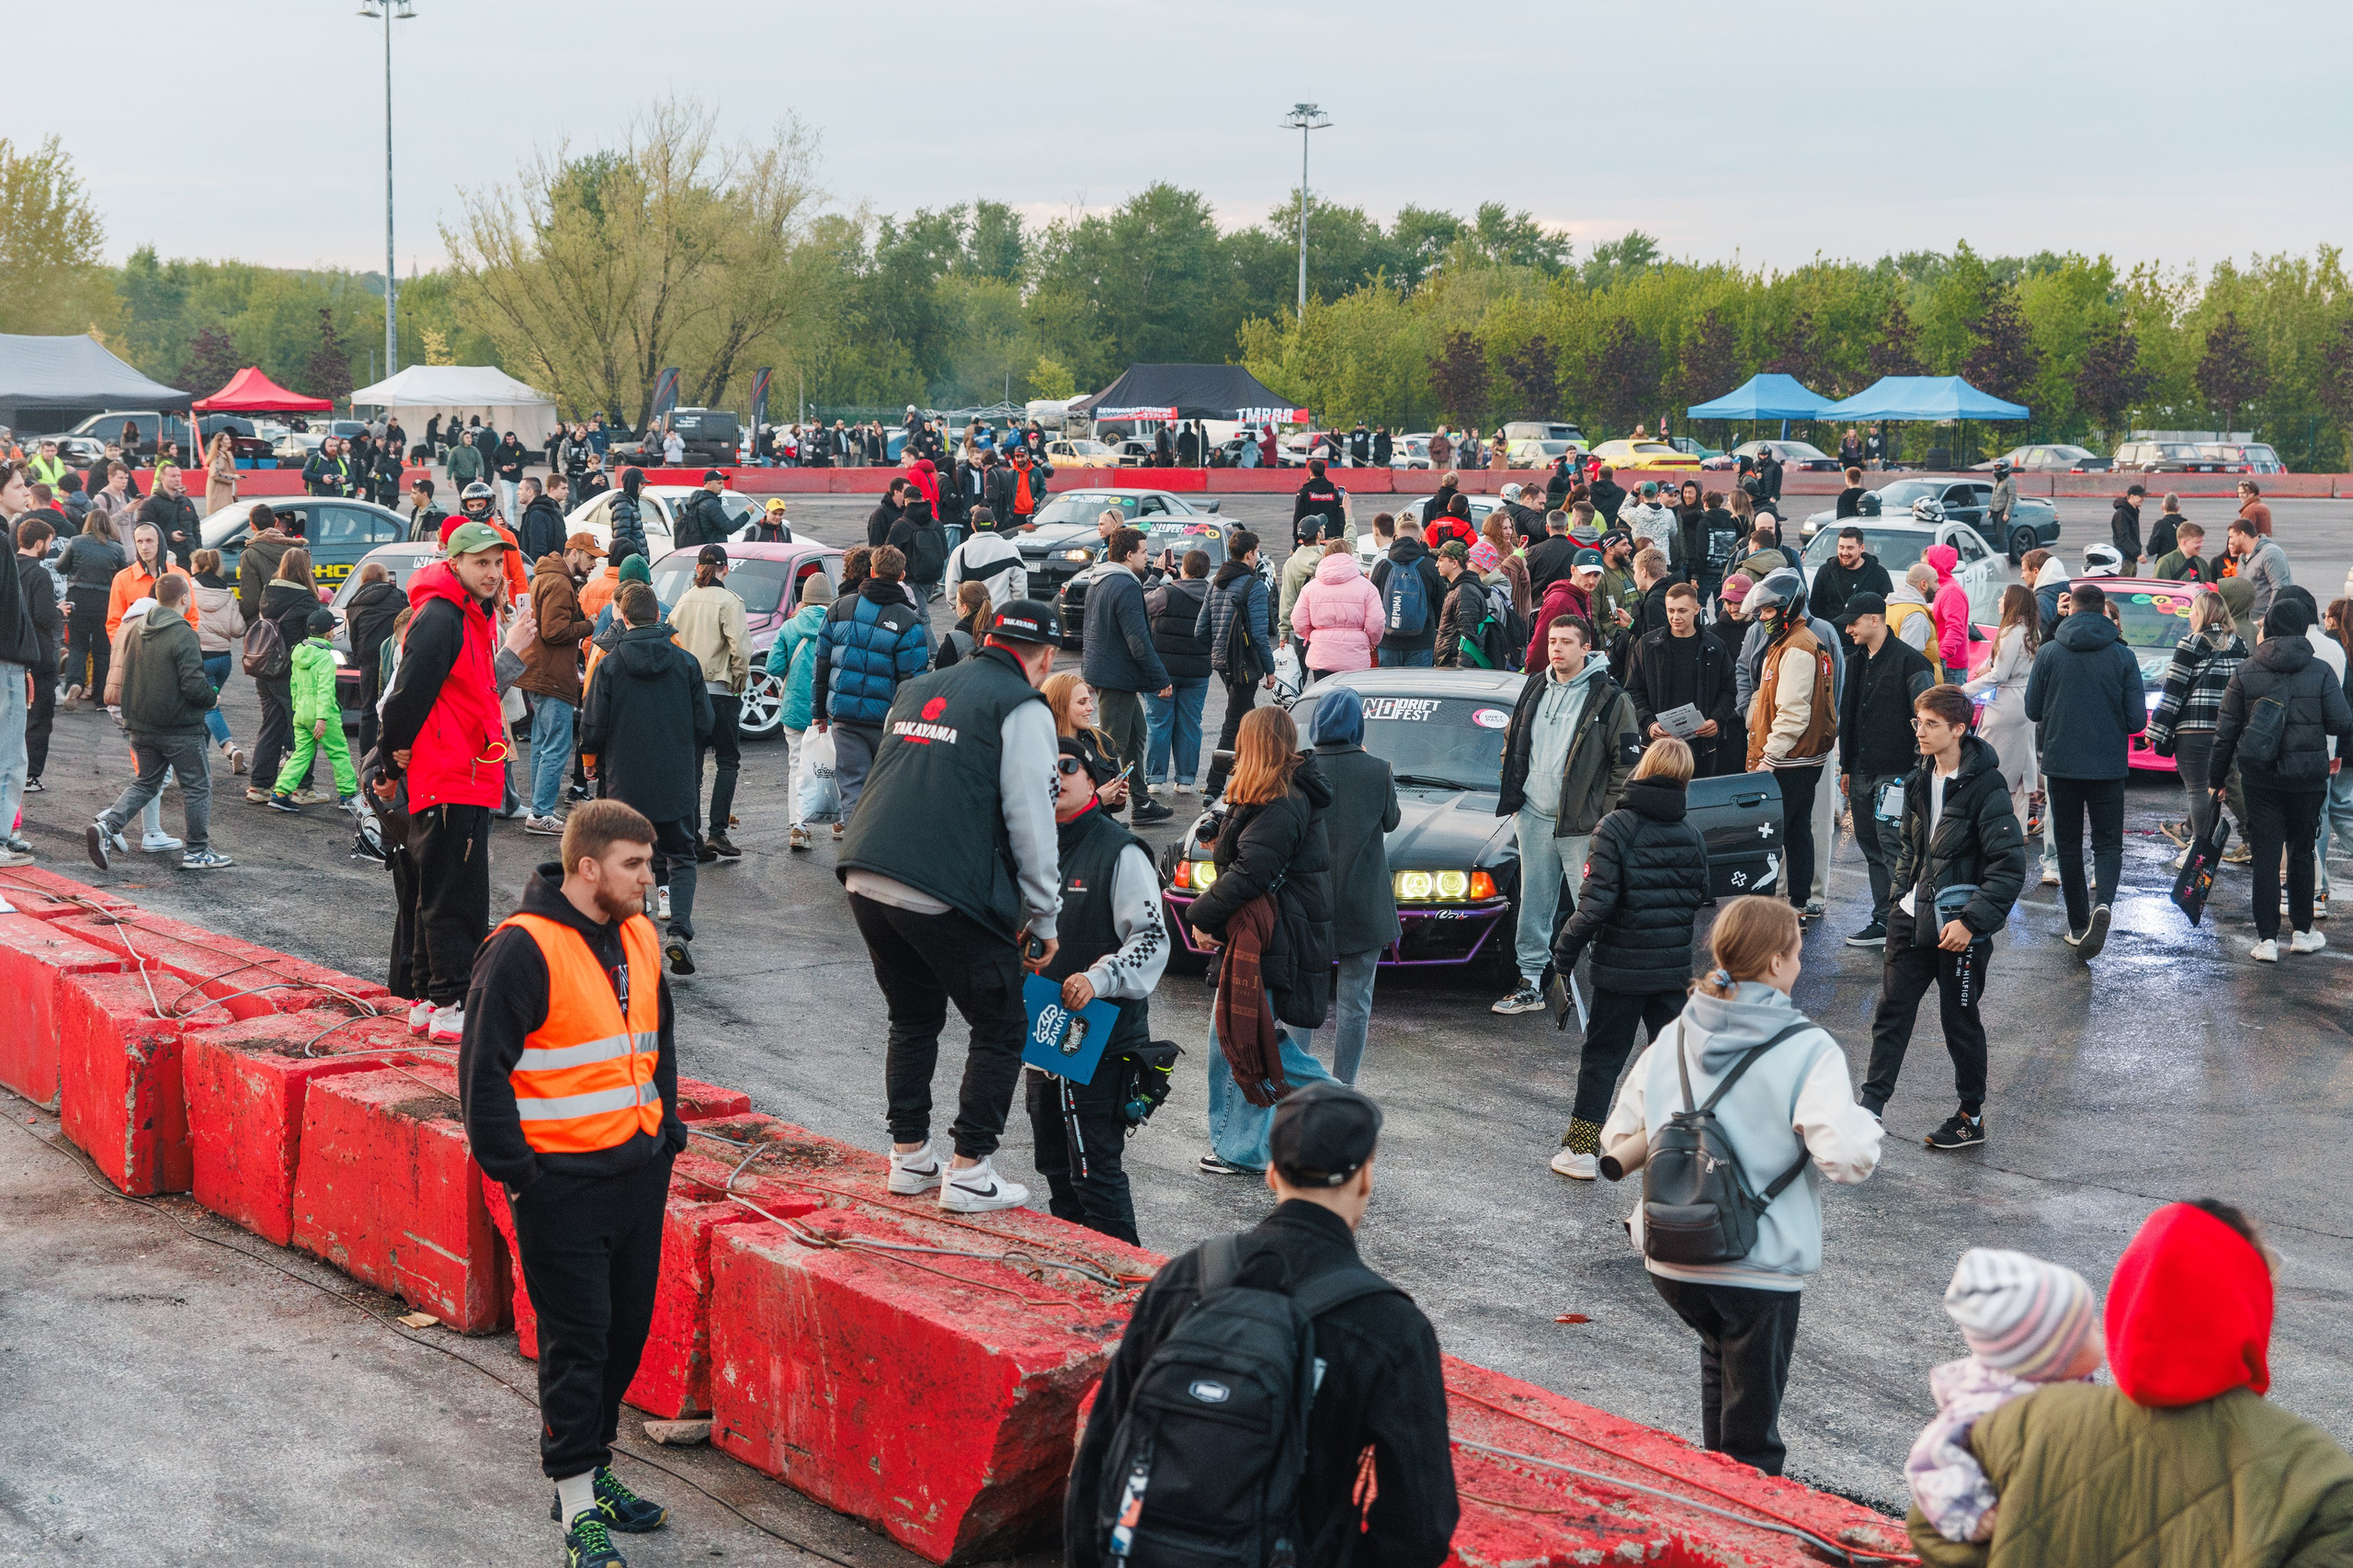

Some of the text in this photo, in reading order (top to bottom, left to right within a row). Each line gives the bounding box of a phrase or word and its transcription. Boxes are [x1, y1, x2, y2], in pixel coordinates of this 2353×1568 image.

[1392, 595, 1402, 617] PUMA
[1003, 617, 1039, 631] TAKAYAMA
[1397, 699, 1442, 711] DRIFT
[1394, 710, 1432, 722] FEST
[892, 721, 958, 744] TAKAYAMA
[1961, 970, 1970, 1007] HILFIGER
